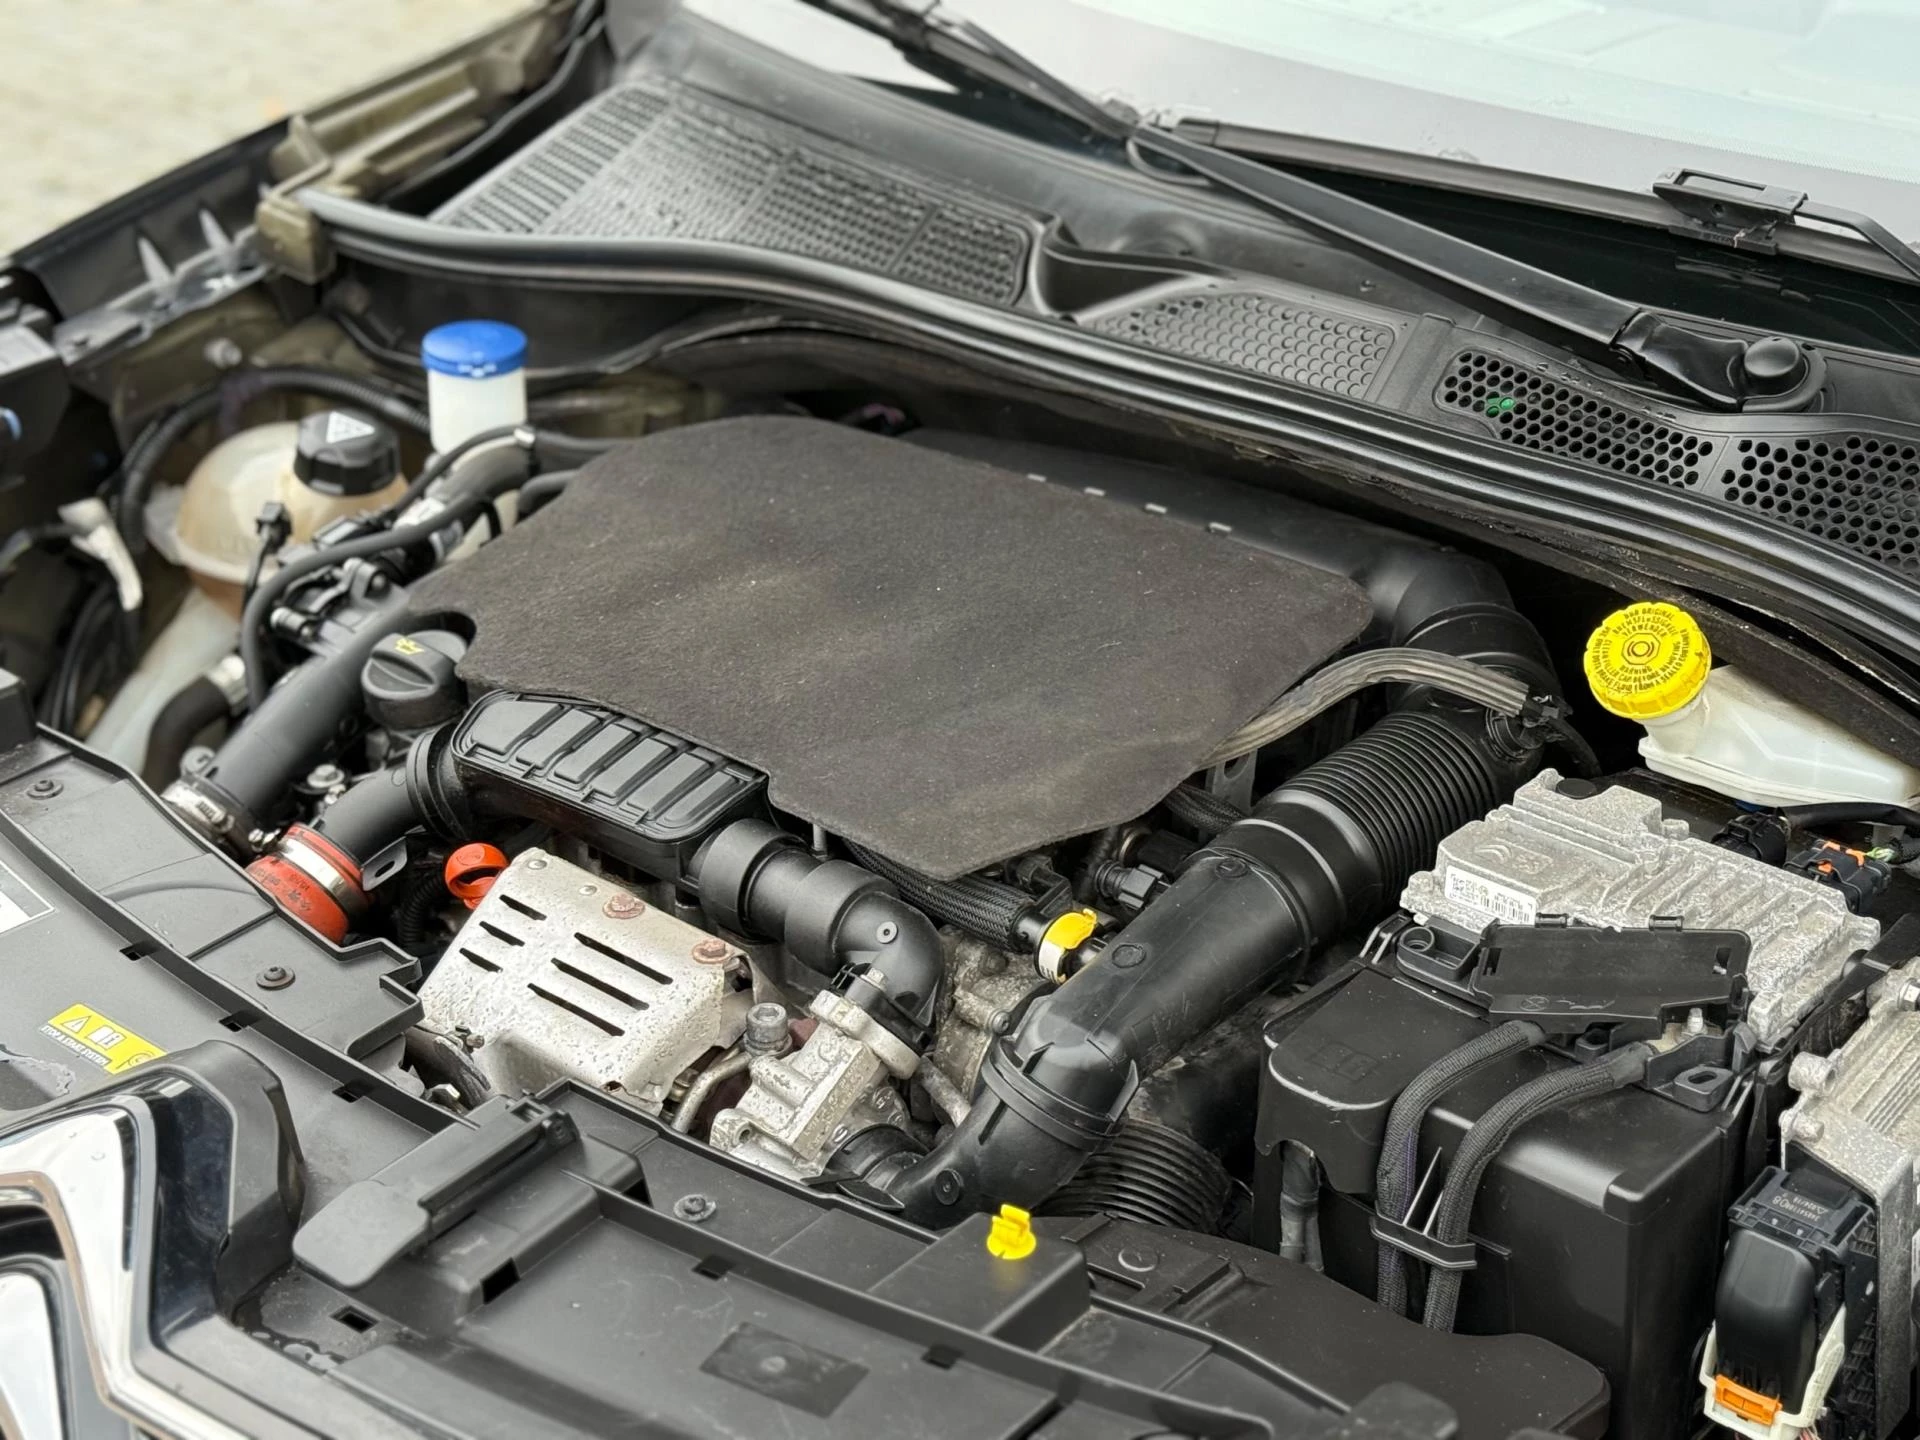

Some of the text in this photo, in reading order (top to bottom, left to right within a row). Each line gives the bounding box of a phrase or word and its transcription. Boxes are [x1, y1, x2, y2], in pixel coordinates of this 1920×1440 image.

[1642, 608, 1675, 620] ORIGINAL
[1598, 626, 1612, 638] USE
[1593, 638, 1604, 654] ONLY
[1603, 662, 1620, 679] FILLER
[1618, 673, 1632, 683] CAP
[1633, 672, 1660, 683] BEFORE
[1620, 665, 1652, 674] WARNING
[1661, 661, 1682, 683] SEALED
[1597, 668, 1614, 688] BRAKE
[1614, 681, 1632, 692] FLUID
[1634, 682, 1655, 693] FROM
